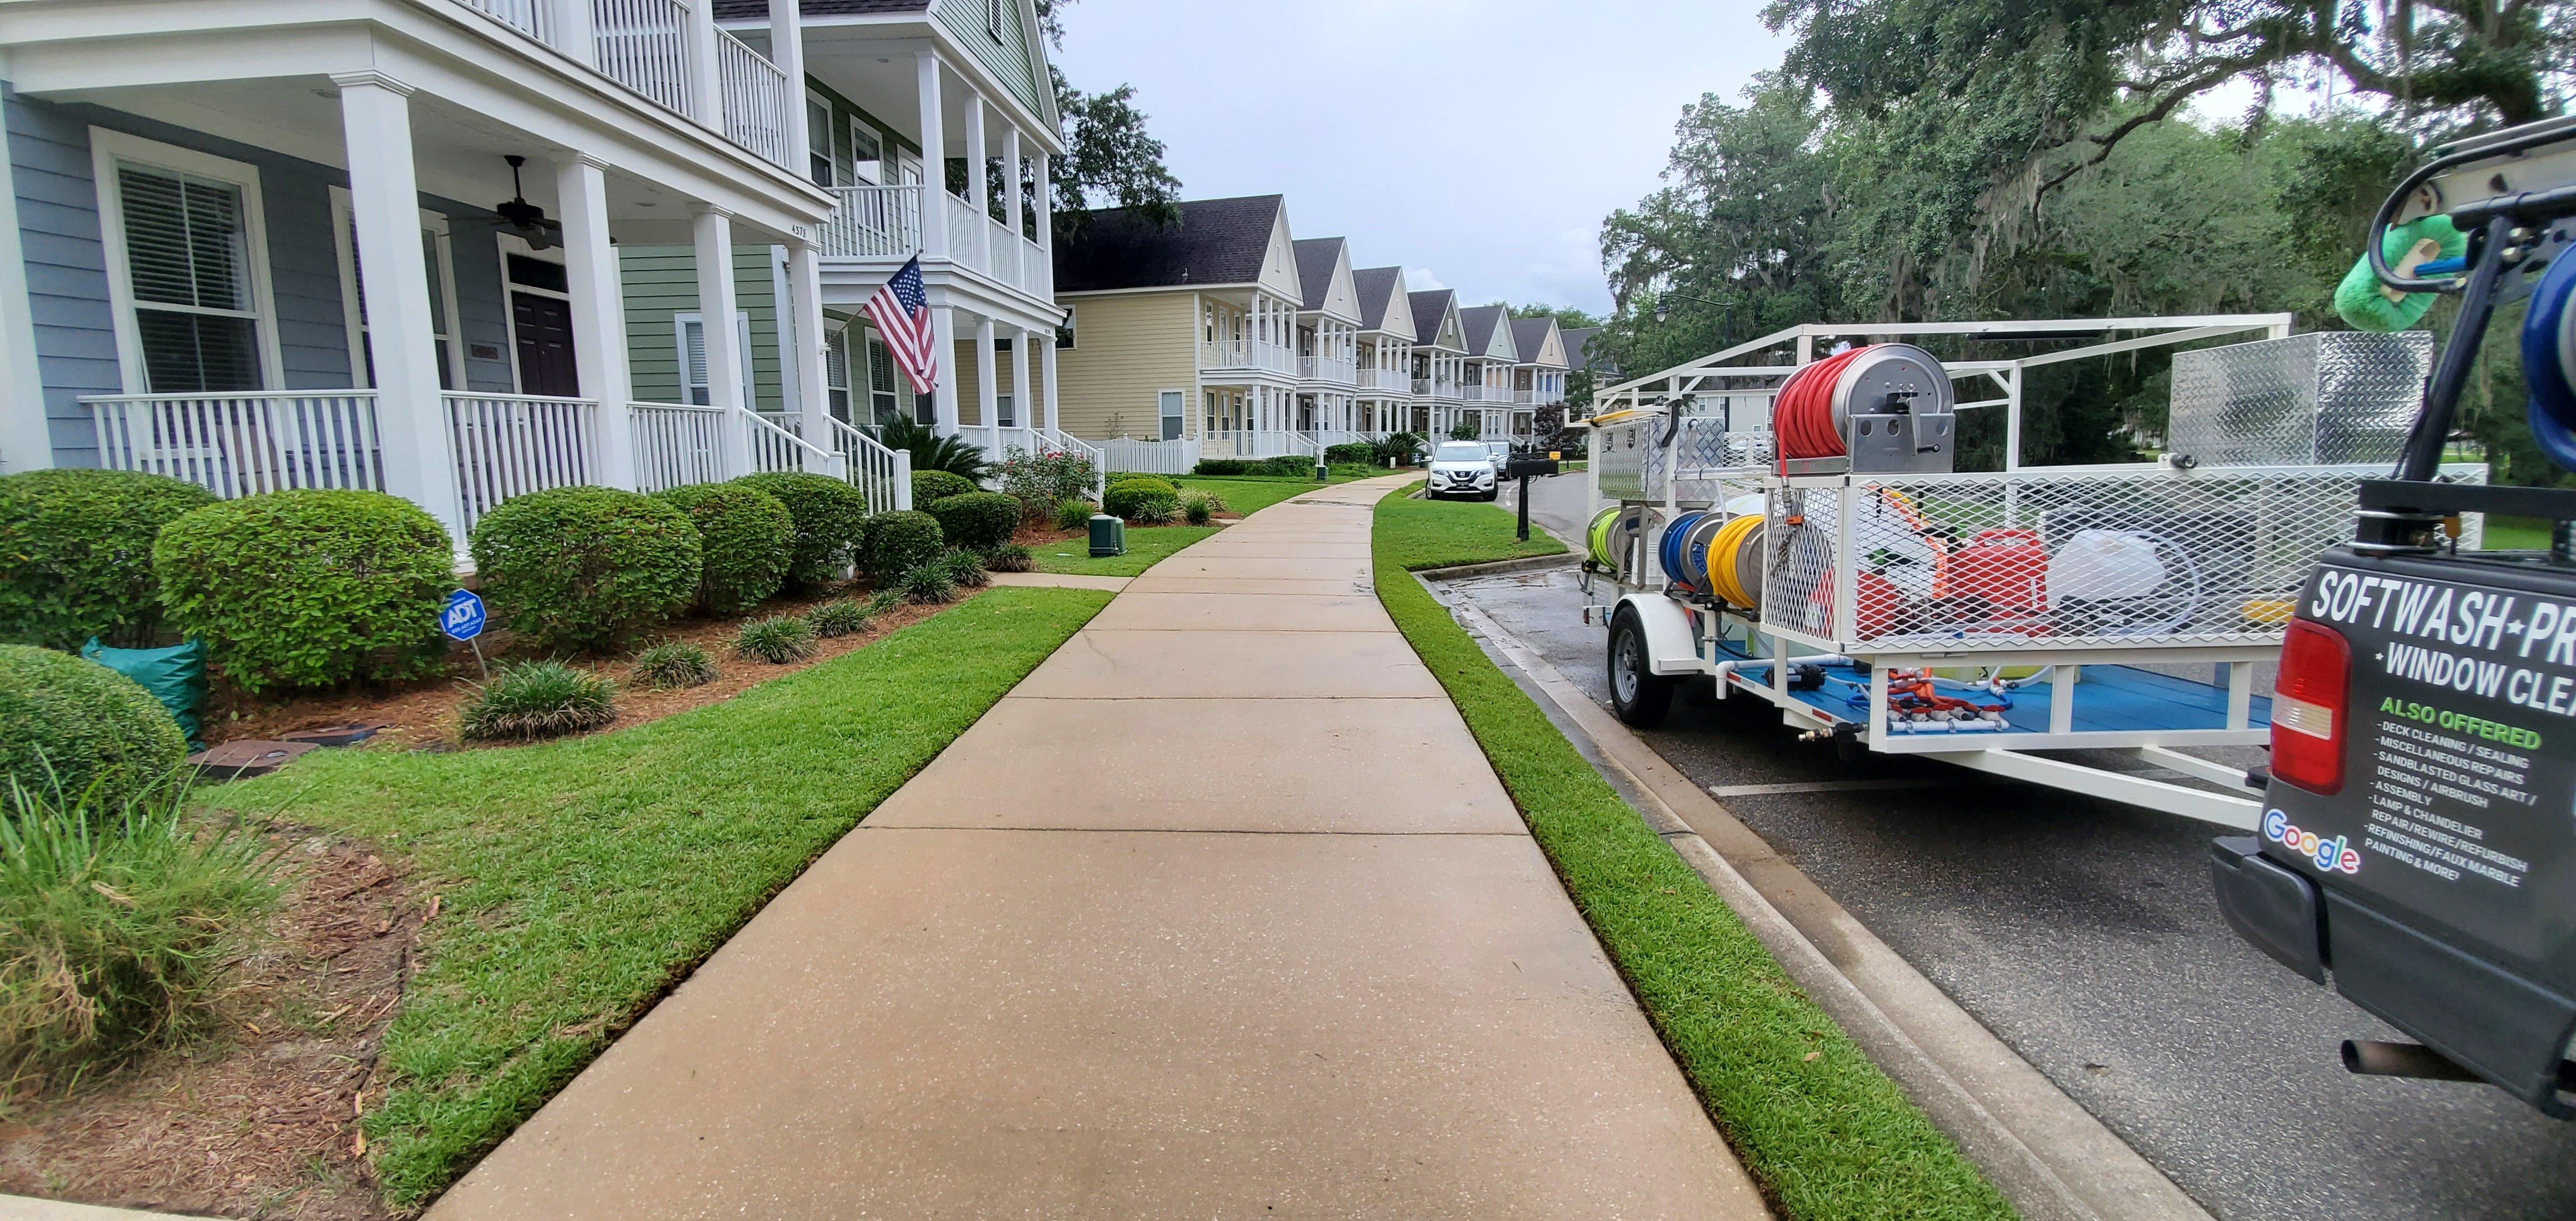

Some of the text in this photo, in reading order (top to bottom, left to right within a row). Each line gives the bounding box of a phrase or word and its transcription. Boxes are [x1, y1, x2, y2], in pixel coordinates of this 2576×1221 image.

[448, 598, 477, 628] ADT
[2312, 571, 2515, 650] SOFTWASH
[2388, 641, 2507, 698] WINDOW
[2379, 697, 2542, 750] ALSO OFFERED
[2411, 728, 2467, 752] CLEANING
[2476, 746, 2530, 769] SEALING
[2377, 765, 2422, 787] DESIGNS
[2430, 782, 2489, 808] AIRBRUSH
[2458, 774, 2499, 794] GLASS
[2499, 787, 2530, 803] ART
[2470, 760, 2526, 785] REPAIRS
[2265, 810, 2359, 872] Google
[2404, 804, 2412, 816] &
[2413, 808, 2483, 840] CHANDELIER
[2365, 837, 2461, 882] PAINTING & MORE!
[2468, 860, 2521, 888] MARBLE
